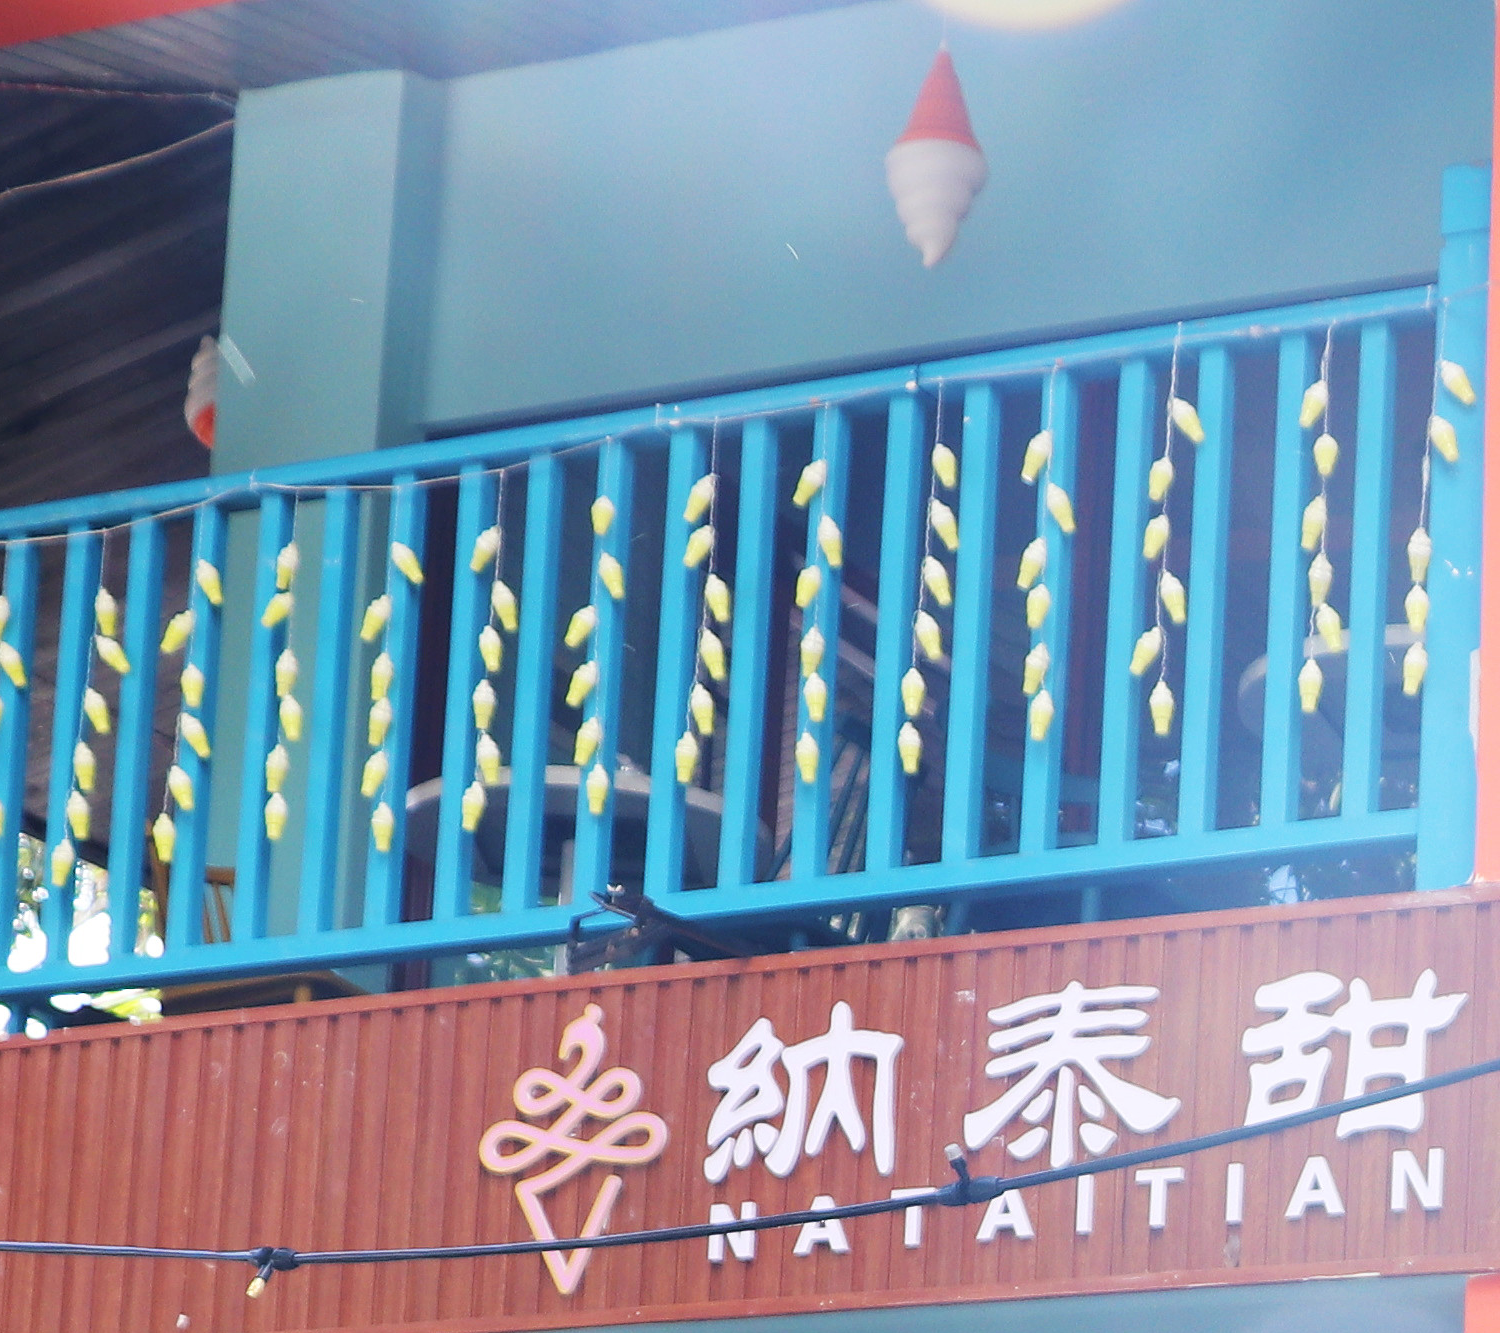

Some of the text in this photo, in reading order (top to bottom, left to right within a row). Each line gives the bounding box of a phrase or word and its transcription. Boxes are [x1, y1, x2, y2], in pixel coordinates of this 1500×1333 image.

[703, 967, 1468, 1185] 納泰甜
[706, 1148, 1446, 1265] NATAITIAN
